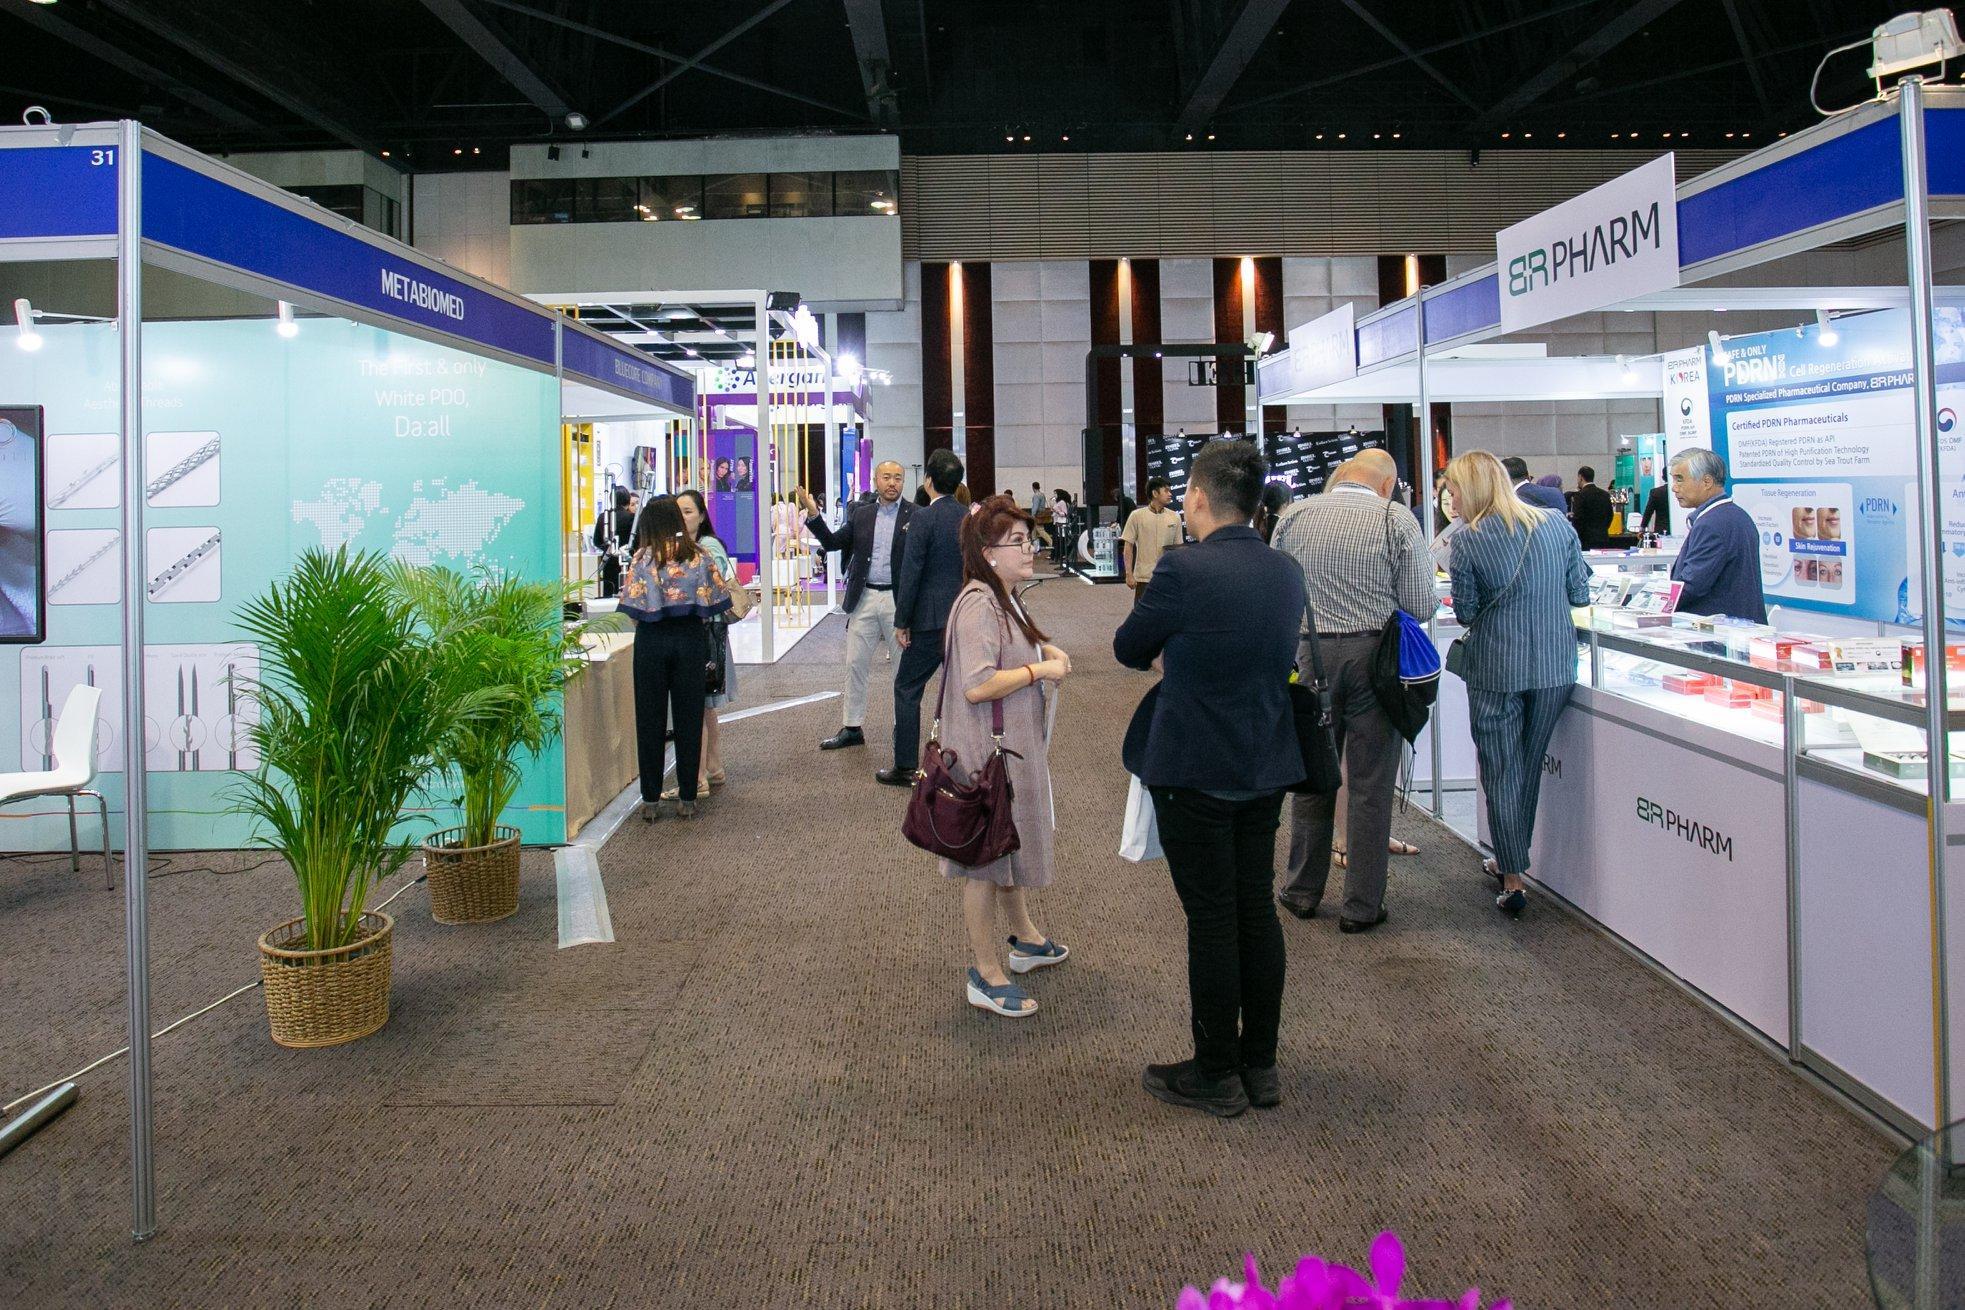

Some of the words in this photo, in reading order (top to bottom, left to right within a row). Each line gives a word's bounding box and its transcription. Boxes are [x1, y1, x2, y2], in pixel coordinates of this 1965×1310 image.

[91, 150, 114, 166] 31
[381, 268, 464, 320] METABIOMED
[1727, 349, 1740, 360] AFE
[1740, 349, 1747, 358] &
[1747, 345, 1767, 357] ONLY
[359, 359, 388, 376] The
[436, 358, 449, 375] &
[453, 357, 487, 377] only
[1724, 355, 1778, 387] PDRN
[1789, 364, 1806, 378] Cell
[743, 370, 826, 388] Aergan
[375, 389, 425, 408] White
[430, 388, 472, 409] PDO,
[1726, 393, 1743, 404] PDRN
[1743, 389, 1777, 402] Specialized
[1778, 383, 1831, 398] Pharmaceutical
[395, 414, 451, 438] Da:all
[1731, 420, 1760, 431] Certified
[1761, 418, 1781, 428] PDRN
[1783, 412, 1849, 426] Pharmaceuticals
[1784, 447, 1798, 458] High
[1834, 444, 1869, 455] Technology
[1772, 458, 1791, 468] Quality
[1792, 457, 1815, 466] Control
[1815, 457, 1823, 467] by
[1824, 456, 1836, 465] Sea
[1837, 456, 1853, 465] Trout
[1854, 455, 1871, 464] Farm
[1761, 488, 1777, 497] Tissue
[1777, 488, 1817, 499] Regeneration
[1866, 497, 1890, 512] PDRN
[1795, 542, 1806, 550] Skin
[1806, 542, 1841, 553] Rejuvenation
